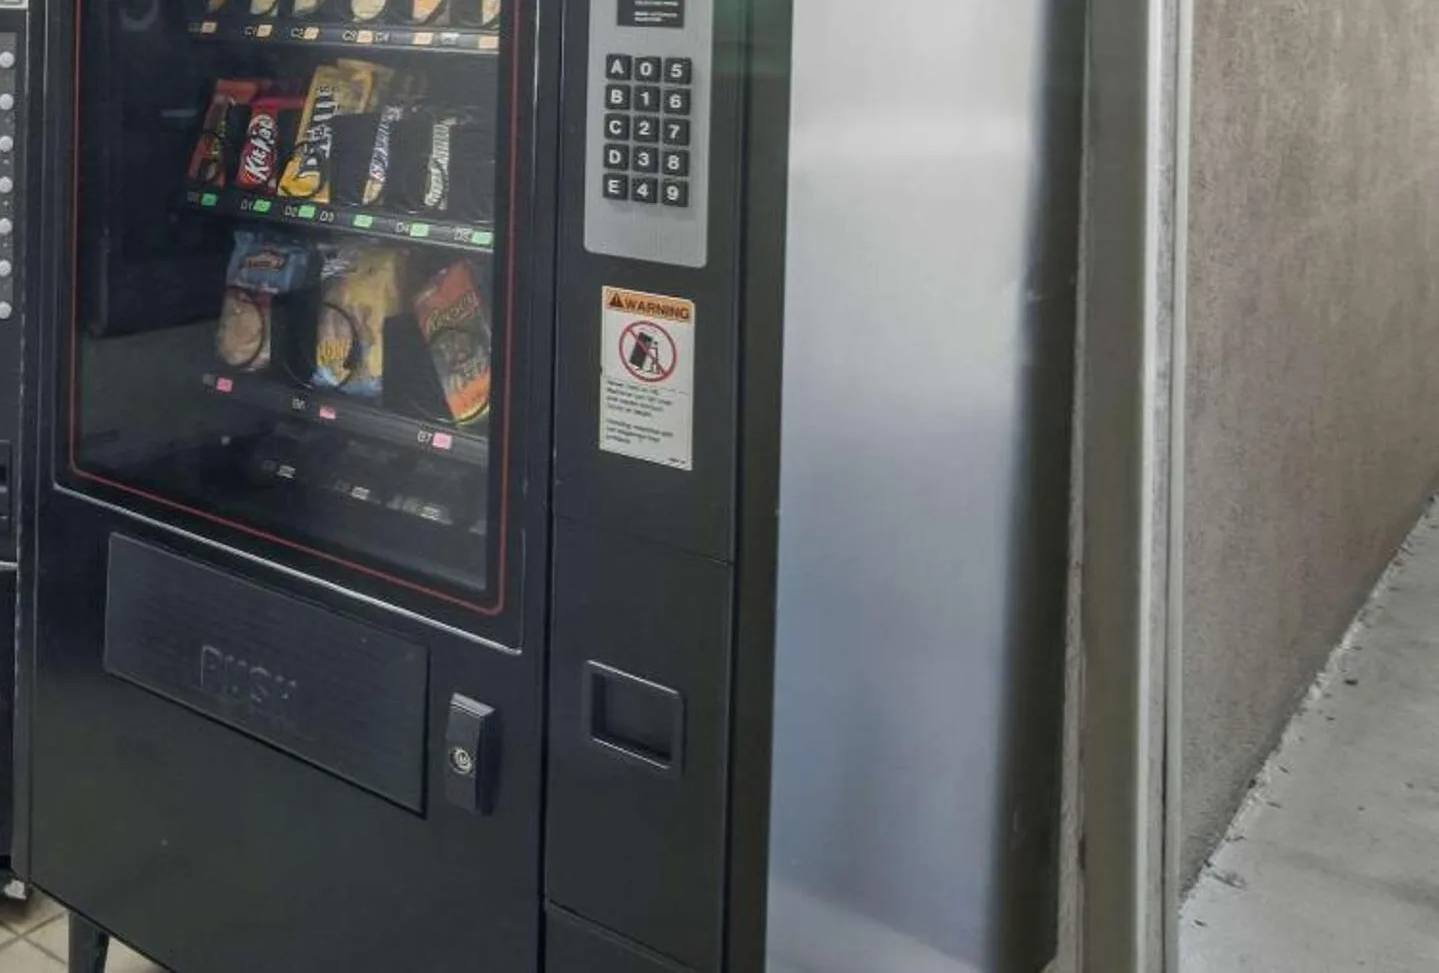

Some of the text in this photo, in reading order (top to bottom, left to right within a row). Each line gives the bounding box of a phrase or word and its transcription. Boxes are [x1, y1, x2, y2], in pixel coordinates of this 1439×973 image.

[611, 59, 682, 78] A 0 5
[610, 89, 681, 108] B 1 6
[609, 119, 680, 139] C 2 7
[609, 149, 679, 170] D 3 8
[607, 180, 679, 200] E 4 9
[624, 296, 690, 320] WARNING
